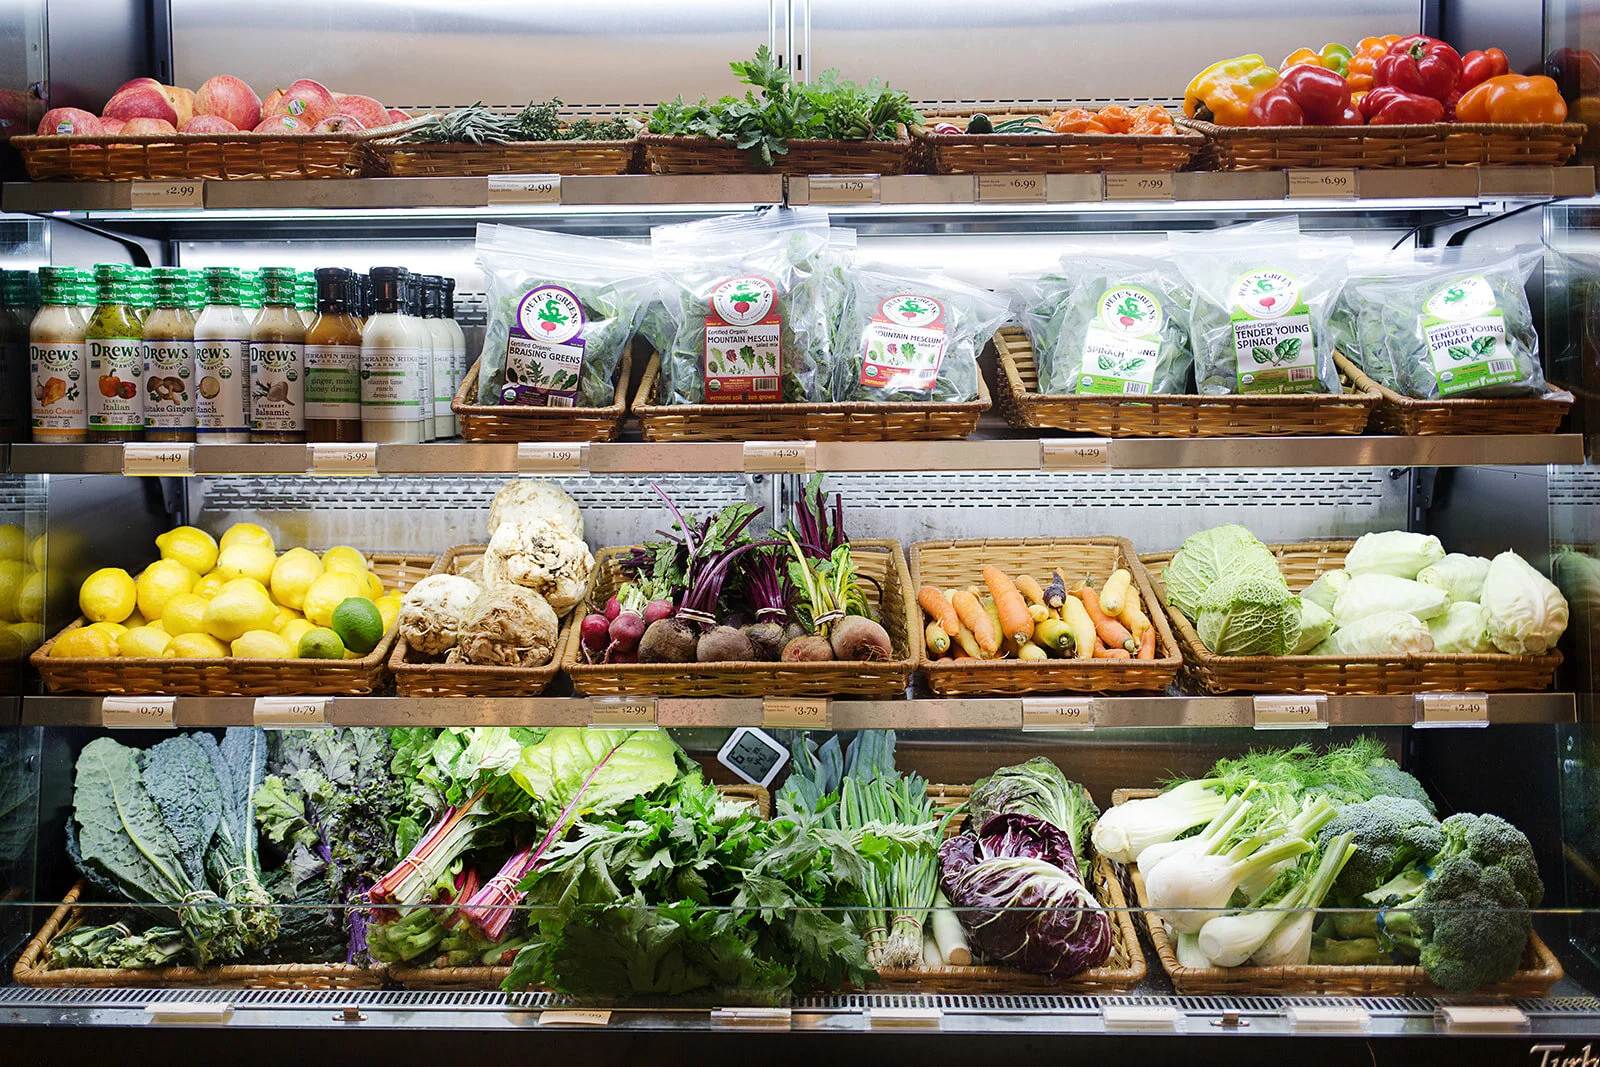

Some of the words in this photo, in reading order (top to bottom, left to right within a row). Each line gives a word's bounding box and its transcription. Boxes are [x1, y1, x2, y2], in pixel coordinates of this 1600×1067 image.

[1010, 179, 1036, 188] $6.99
[1138, 179, 1163, 188] $7.99
[1321, 176, 1346, 186] $6.99
[166, 186, 194, 197] $2.99
[524, 184, 552, 194] $2.99
[840, 182, 864, 191] $1.79
[1236, 328, 1273, 340] TENDER
[1276, 324, 1309, 335] YOUNG
[1428, 325, 1449, 336] Certified
[1450, 322, 1471, 330] Organic
[1429, 327, 1468, 343] TENDER
[1470, 325, 1504, 333] YOUNG
[747, 335, 779, 343] MESCLUN
[876, 329, 908, 340] OUNTAIN
[910, 335, 941, 344] MESCLUN
[510, 340, 531, 349] Certified
[532, 343, 552, 352] Organic
[1237, 337, 1278, 349] SPINACH
[1431, 335, 1474, 351] SPINACH
[509, 347, 547, 359] BRAISING
[549, 352, 580, 364] GREENS
[1087, 345, 1124, 358] SPINACH
[166, 405, 194, 413] Ginger
[156, 453, 181, 462] $4.49
[344, 452, 368, 462] $5.99
[548, 452, 571, 461] $1.99
[774, 450, 798, 458] $4.29
[1074, 448, 1100, 458] $4.29
[137, 706, 164, 716] $0.79
[289, 705, 315, 716] $0.79
[622, 706, 646, 715] $2.99
[794, 706, 818, 716] $3.79
[1056, 708, 1079, 717] $1.99
[1285, 705, 1310, 715] $2.49
[1455, 704, 1480, 713] $2.49
